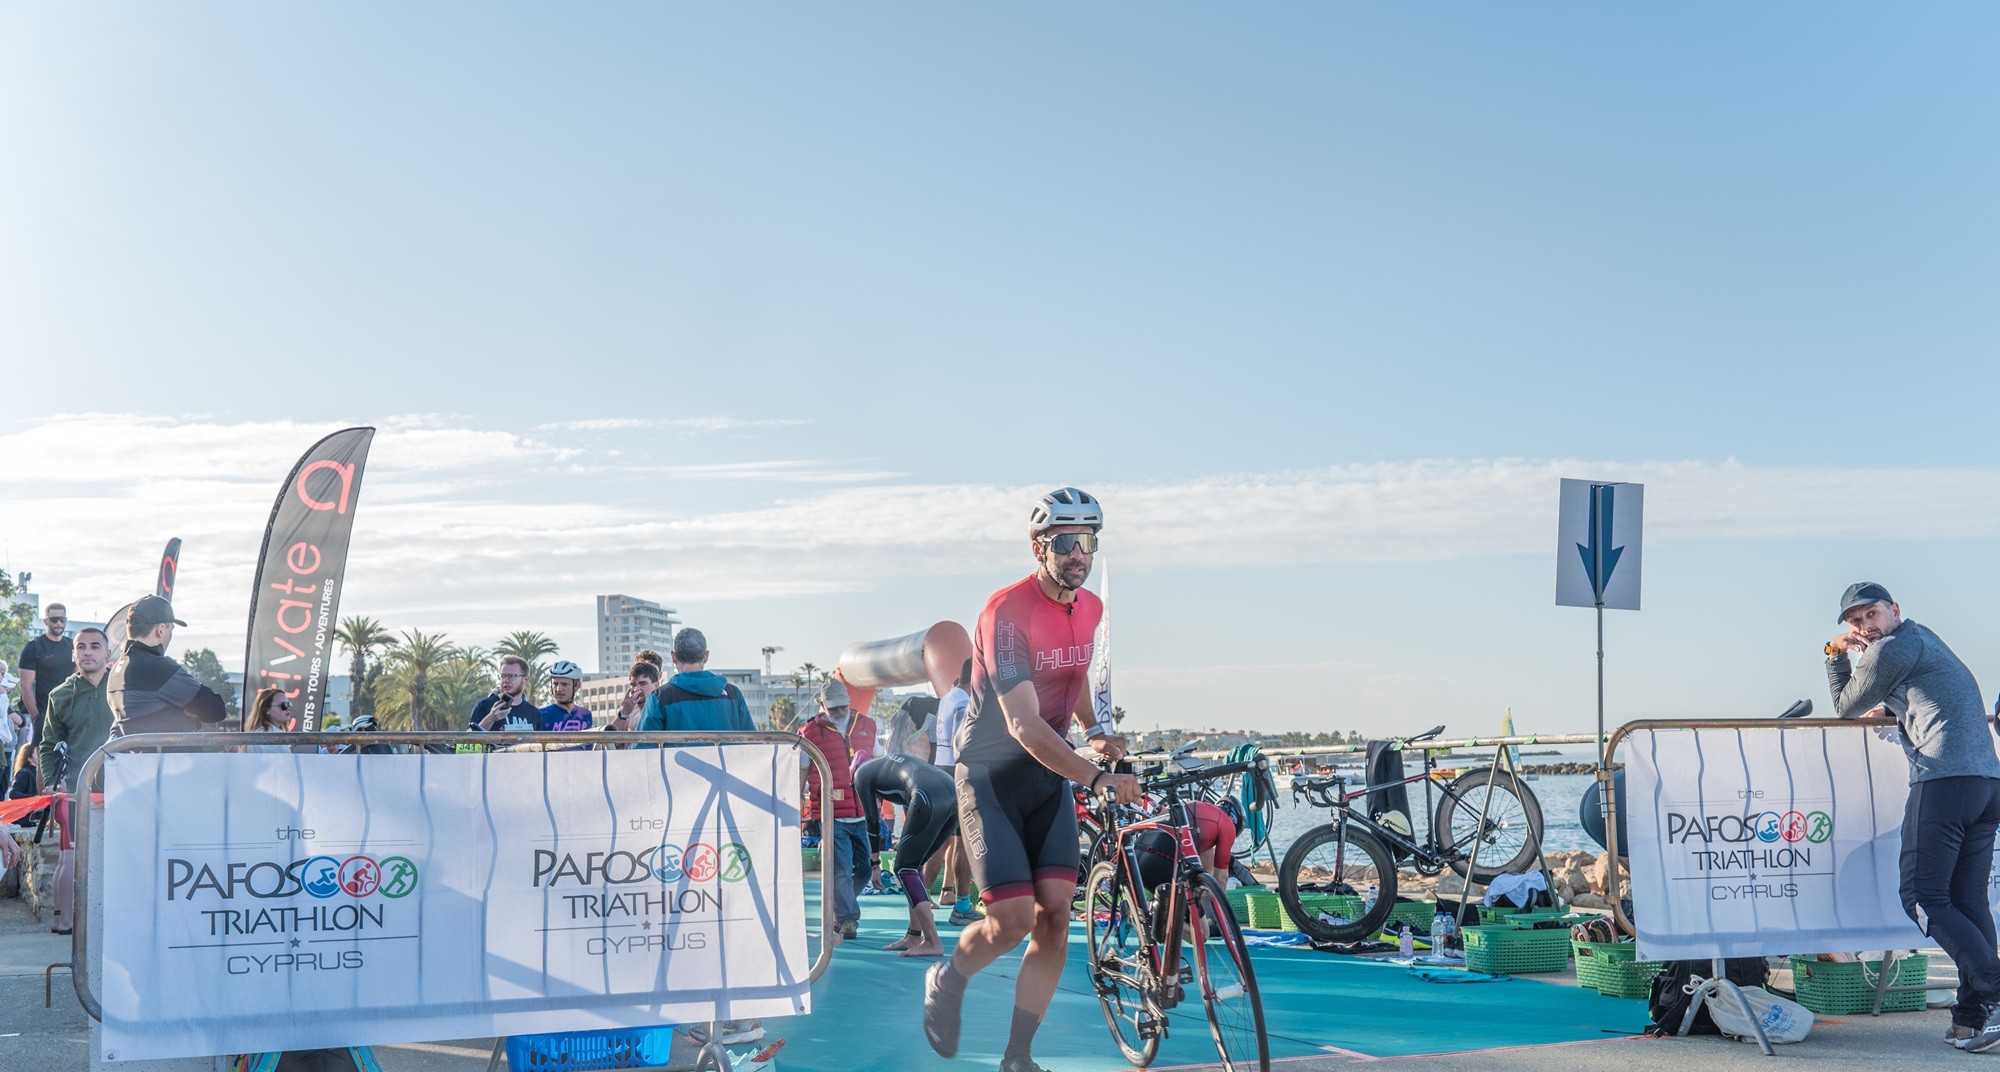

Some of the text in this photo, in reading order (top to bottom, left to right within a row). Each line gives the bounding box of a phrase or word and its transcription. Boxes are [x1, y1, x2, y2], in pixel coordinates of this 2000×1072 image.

[314, 578, 335, 650] ADVENTURES
[997, 620, 1018, 681] HUUB
[307, 657, 322, 694] TOURS
[1737, 788, 1765, 800] the
[275, 825, 316, 841] the
[629, 816, 664, 831] the
[956, 778, 989, 860] HUUB
[1667, 811, 1762, 844] PAFOS
[532, 845, 658, 888] PAFOS
[1691, 848, 1812, 871] TRIATHLON
[167, 857, 311, 901] PAFOS
[1711, 883, 1799, 901] CYPRUS
[200, 903, 384, 936] TRIATHLON
[562, 888, 723, 920] TRIATHLON
[586, 932, 707, 956] CYPRUS
[227, 950, 364, 975] CYPRUS
